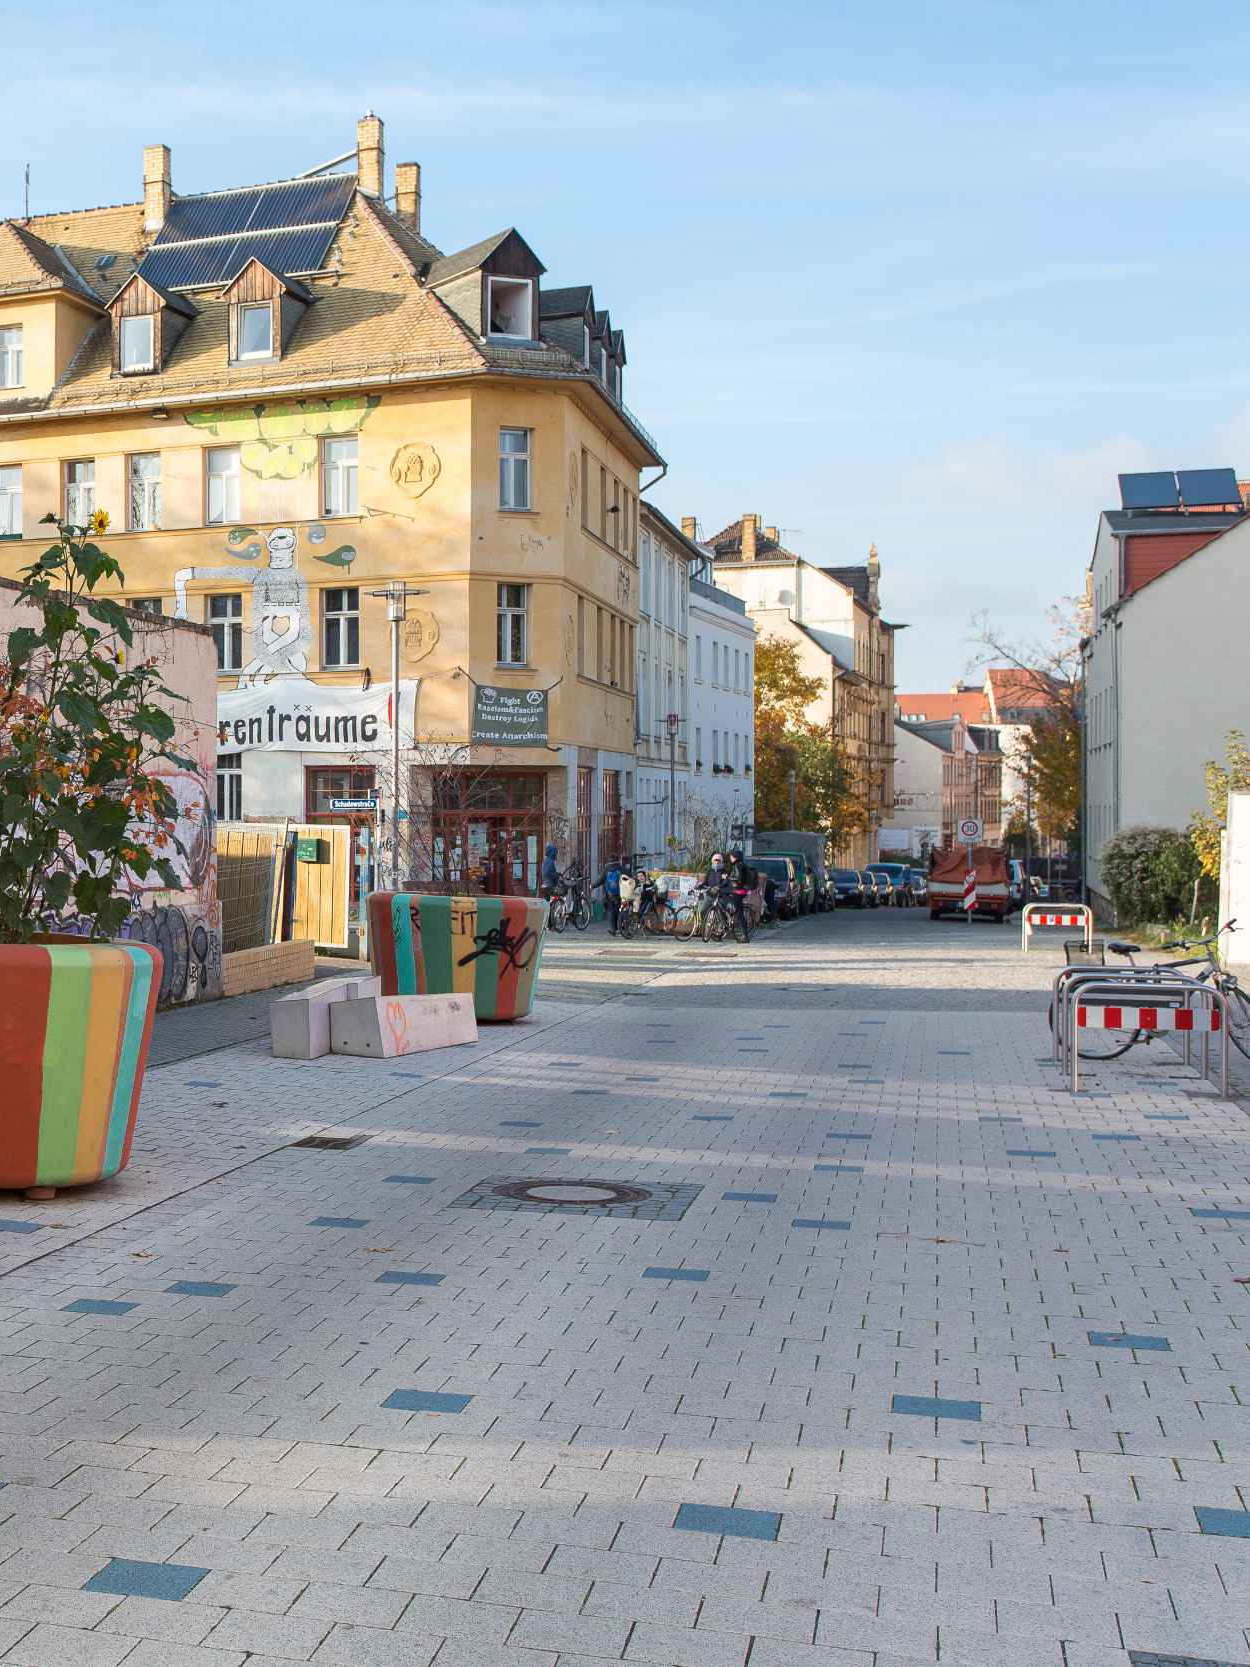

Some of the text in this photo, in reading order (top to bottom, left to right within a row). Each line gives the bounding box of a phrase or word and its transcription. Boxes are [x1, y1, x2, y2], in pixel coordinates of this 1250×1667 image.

[500, 697, 521, 705] Fight
[481, 713, 512, 723] Destroy
[472, 730, 548, 740] Create Anarchism
